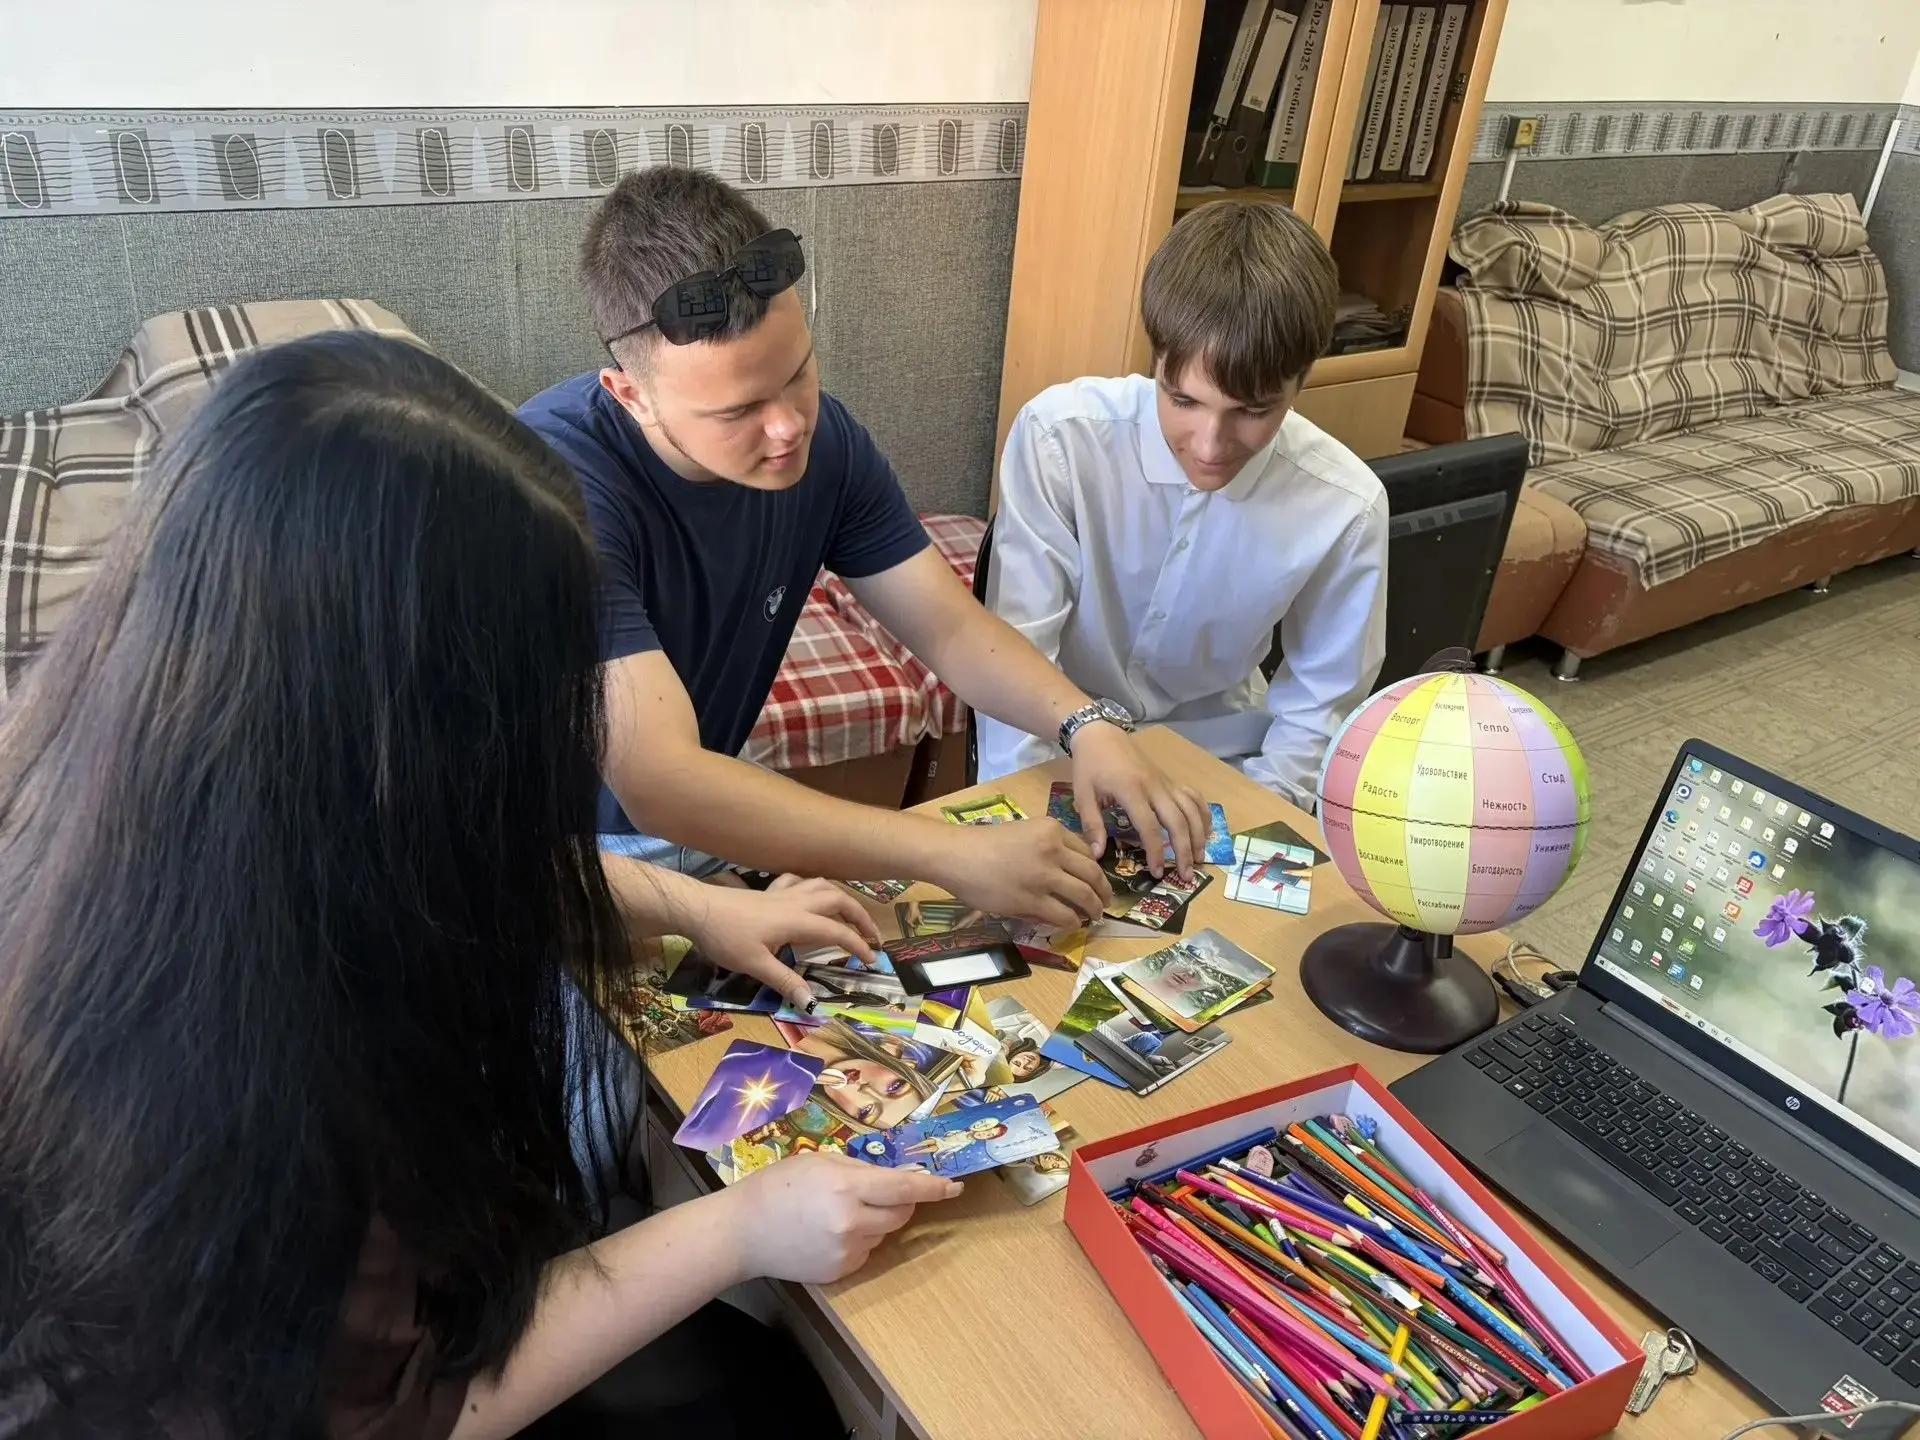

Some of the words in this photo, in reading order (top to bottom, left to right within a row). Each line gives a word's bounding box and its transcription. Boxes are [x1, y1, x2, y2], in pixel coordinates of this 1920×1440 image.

[1300, 1, 1325, 71] 2024-2025
[1407, 12, 1427, 68] 2016-2017
[1440, 16, 1457, 69] 2016-2017
[1285, 75, 1304, 134] учебный
[1278, 140, 1288, 160] год
[1387, 141, 1399, 167] ГОД
[1416, 140, 1429, 164] ГОД
[1477, 722, 1510, 733] Тепло
[1417, 764, 1468, 781] Удовольствие
[1542, 773, 1566, 784] Стыд
[1362, 781, 1399, 799] Радость
[1482, 799, 1528, 811] Нежность
[1410, 834, 1465, 849] Умиротворение
[1535, 843, 1571, 853] Унижение
[1358, 849, 1404, 866] Восхищение
[1472, 864, 1524, 877] Благодарность
[1417, 899, 1461, 911] Расслабление
[1785, 1096, 1800, 1110] hp
